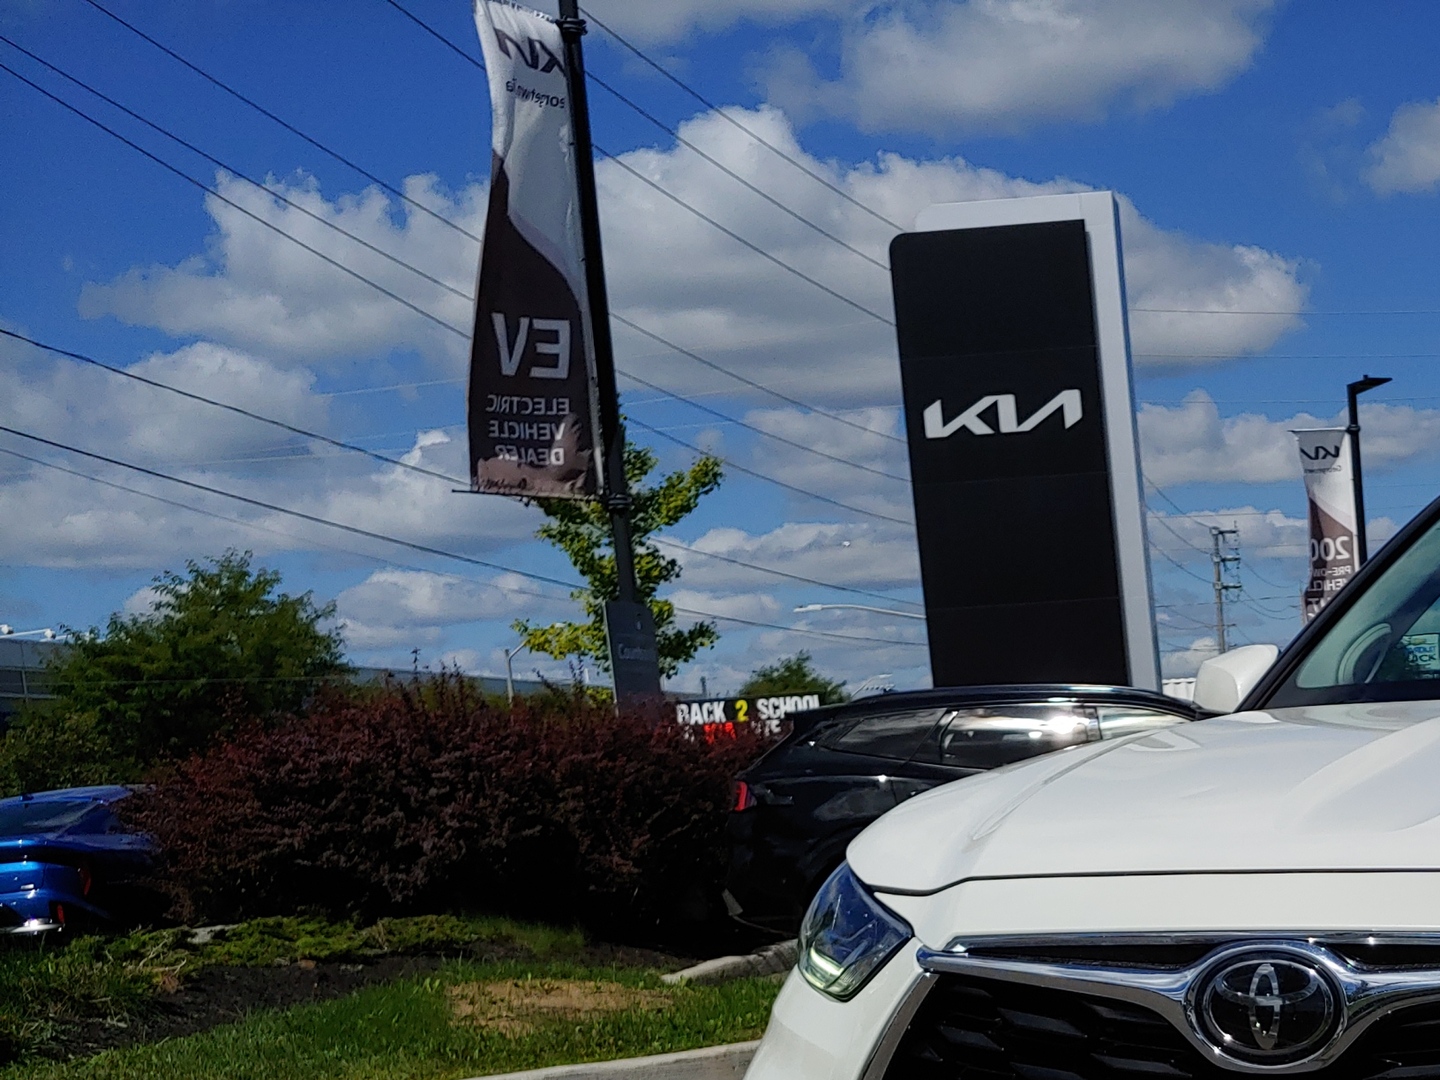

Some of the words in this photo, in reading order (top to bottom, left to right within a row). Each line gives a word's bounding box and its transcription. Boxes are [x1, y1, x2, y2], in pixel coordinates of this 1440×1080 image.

[923, 389, 1083, 439] KIA
[676, 700, 727, 725] BACK
[735, 699, 750, 723] 2
